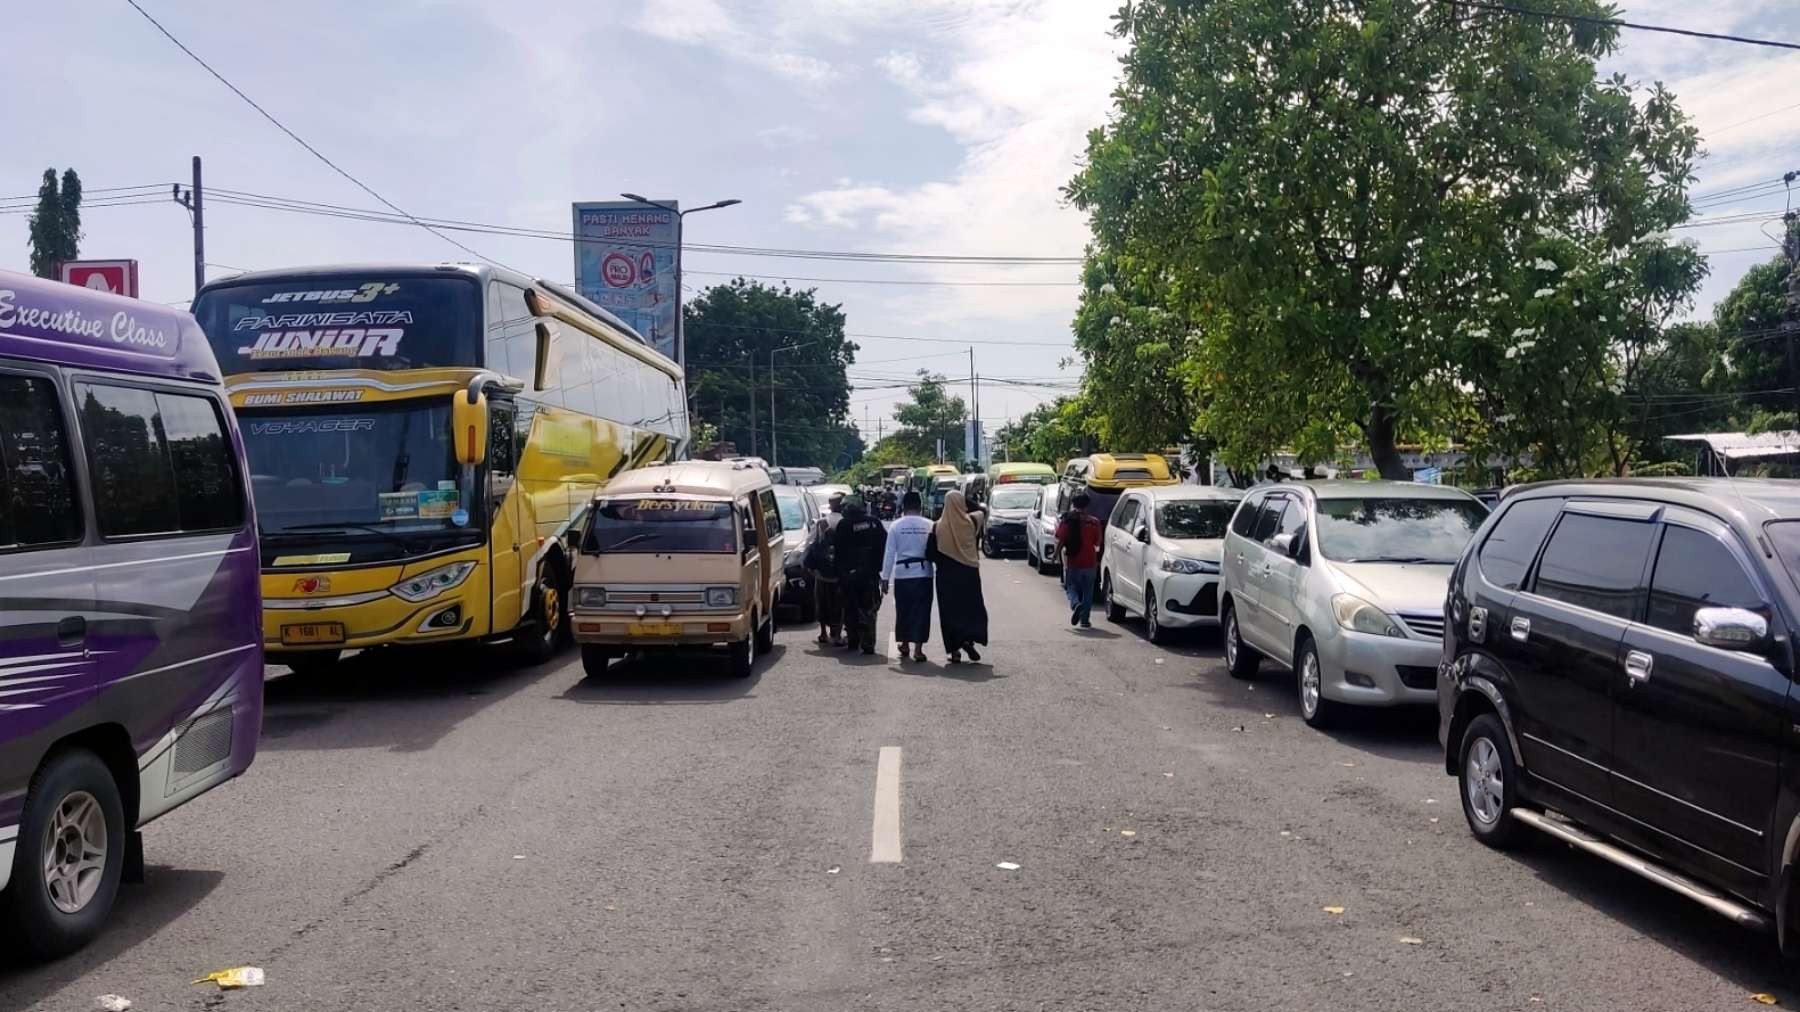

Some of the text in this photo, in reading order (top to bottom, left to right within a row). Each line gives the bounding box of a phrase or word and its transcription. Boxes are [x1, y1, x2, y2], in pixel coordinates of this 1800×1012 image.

[583, 214, 618, 225] PASTI
[604, 226, 649, 236] BANYAK
[262, 289, 356, 303] JETBUS
[0, 290, 166, 347] Executive Class
[235, 311, 413, 331] PARIWISATA
[244, 390, 363, 405] BUMI SHALAWAT
[251, 418, 375, 435] VOYAGER
